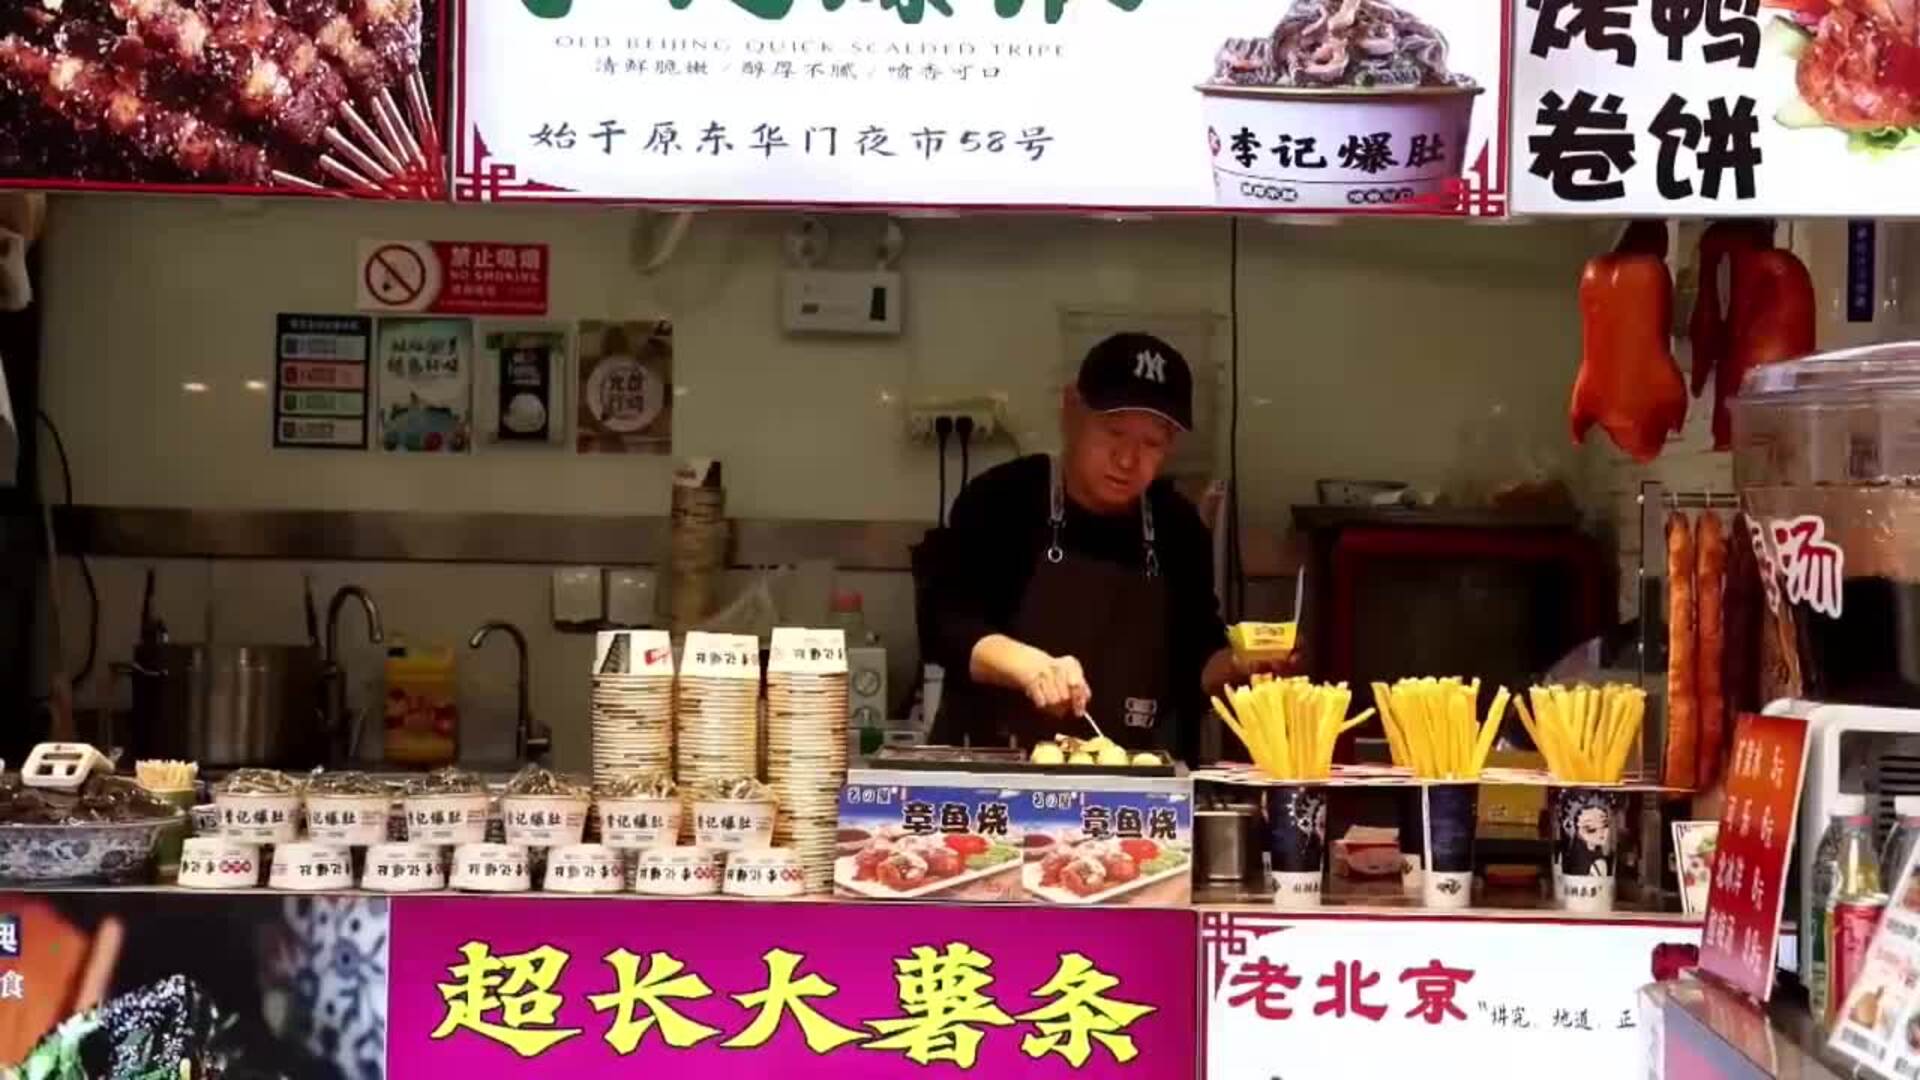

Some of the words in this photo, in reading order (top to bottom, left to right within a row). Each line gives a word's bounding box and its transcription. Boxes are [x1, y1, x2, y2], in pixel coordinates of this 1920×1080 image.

[554, 35, 610, 48] OLD
[627, 37, 730, 50] BEIJING
[745, 39, 834, 54] QUICK
[852, 42, 977, 56] SCALDED
[988, 44, 1066, 58] TRIPE
[529, 121, 1054, 160] 始于原东华门夜市58号
[1230, 126, 1446, 174] 李记爆肚
[1529, 89, 1762, 200] 卷饼
[1133, 350, 1166, 384] NY
[903, 800, 1009, 835] 章鱼烧
[1082, 806, 1177, 839] 章鱼烧
[431, 941, 1158, 1067] 超长大薯条
[1227, 957, 1476, 1024] 老北京
